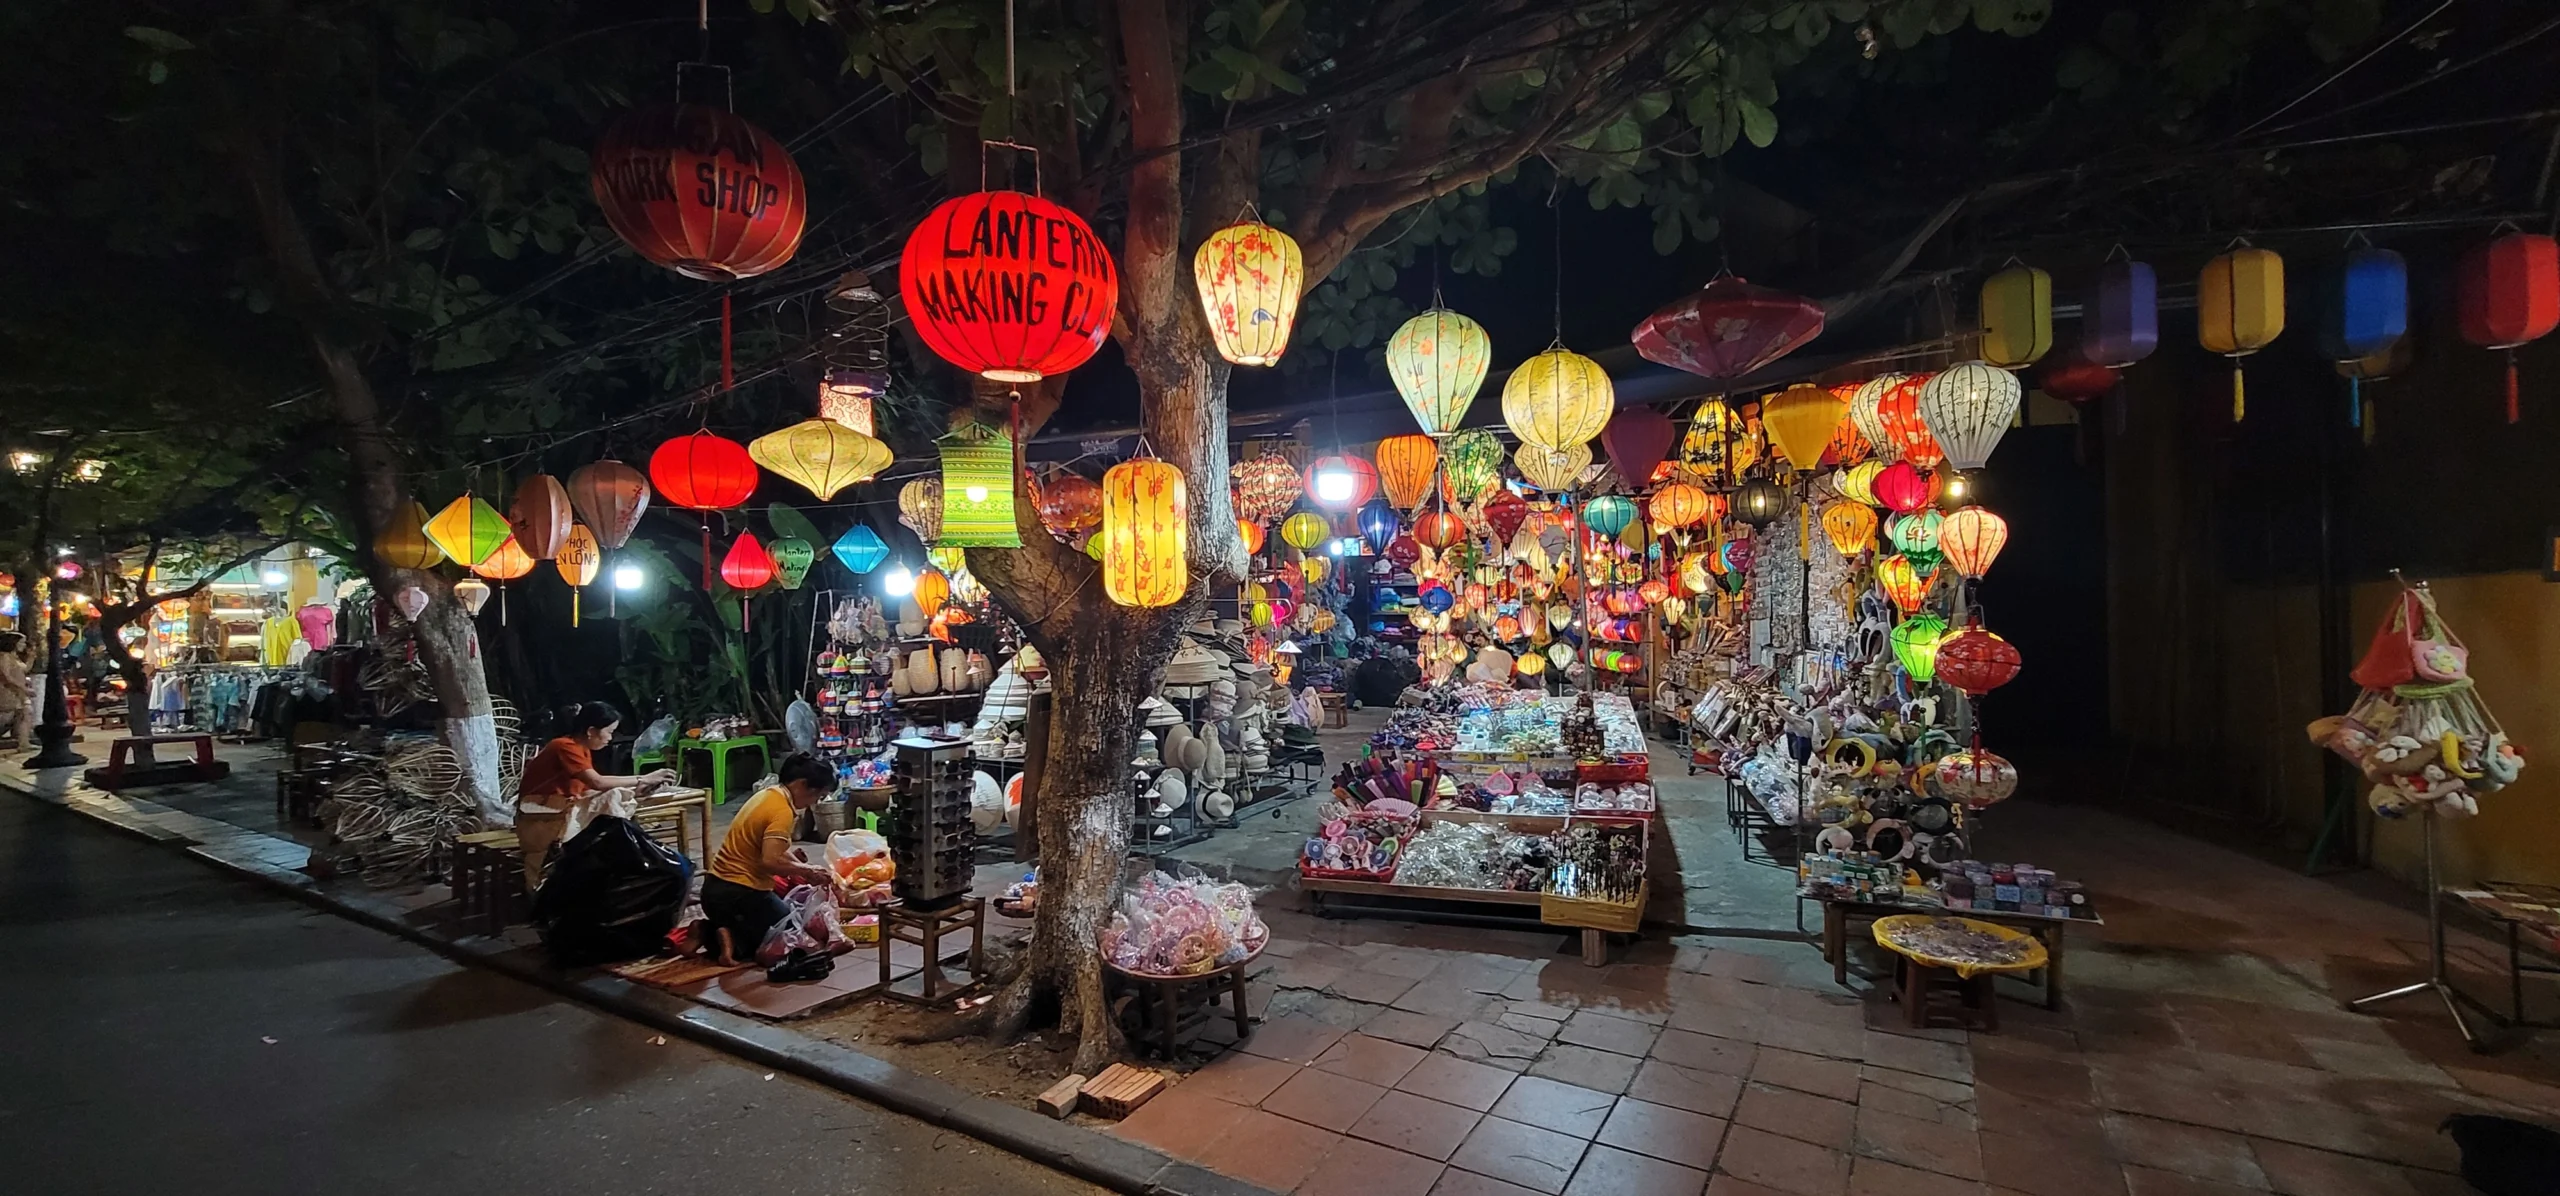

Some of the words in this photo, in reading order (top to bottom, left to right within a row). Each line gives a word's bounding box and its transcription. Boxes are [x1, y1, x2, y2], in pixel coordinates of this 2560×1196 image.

[696, 162, 779, 221] SHOP
[942, 206, 1108, 283] LANTERN
[916, 268, 1048, 327] MAKING
